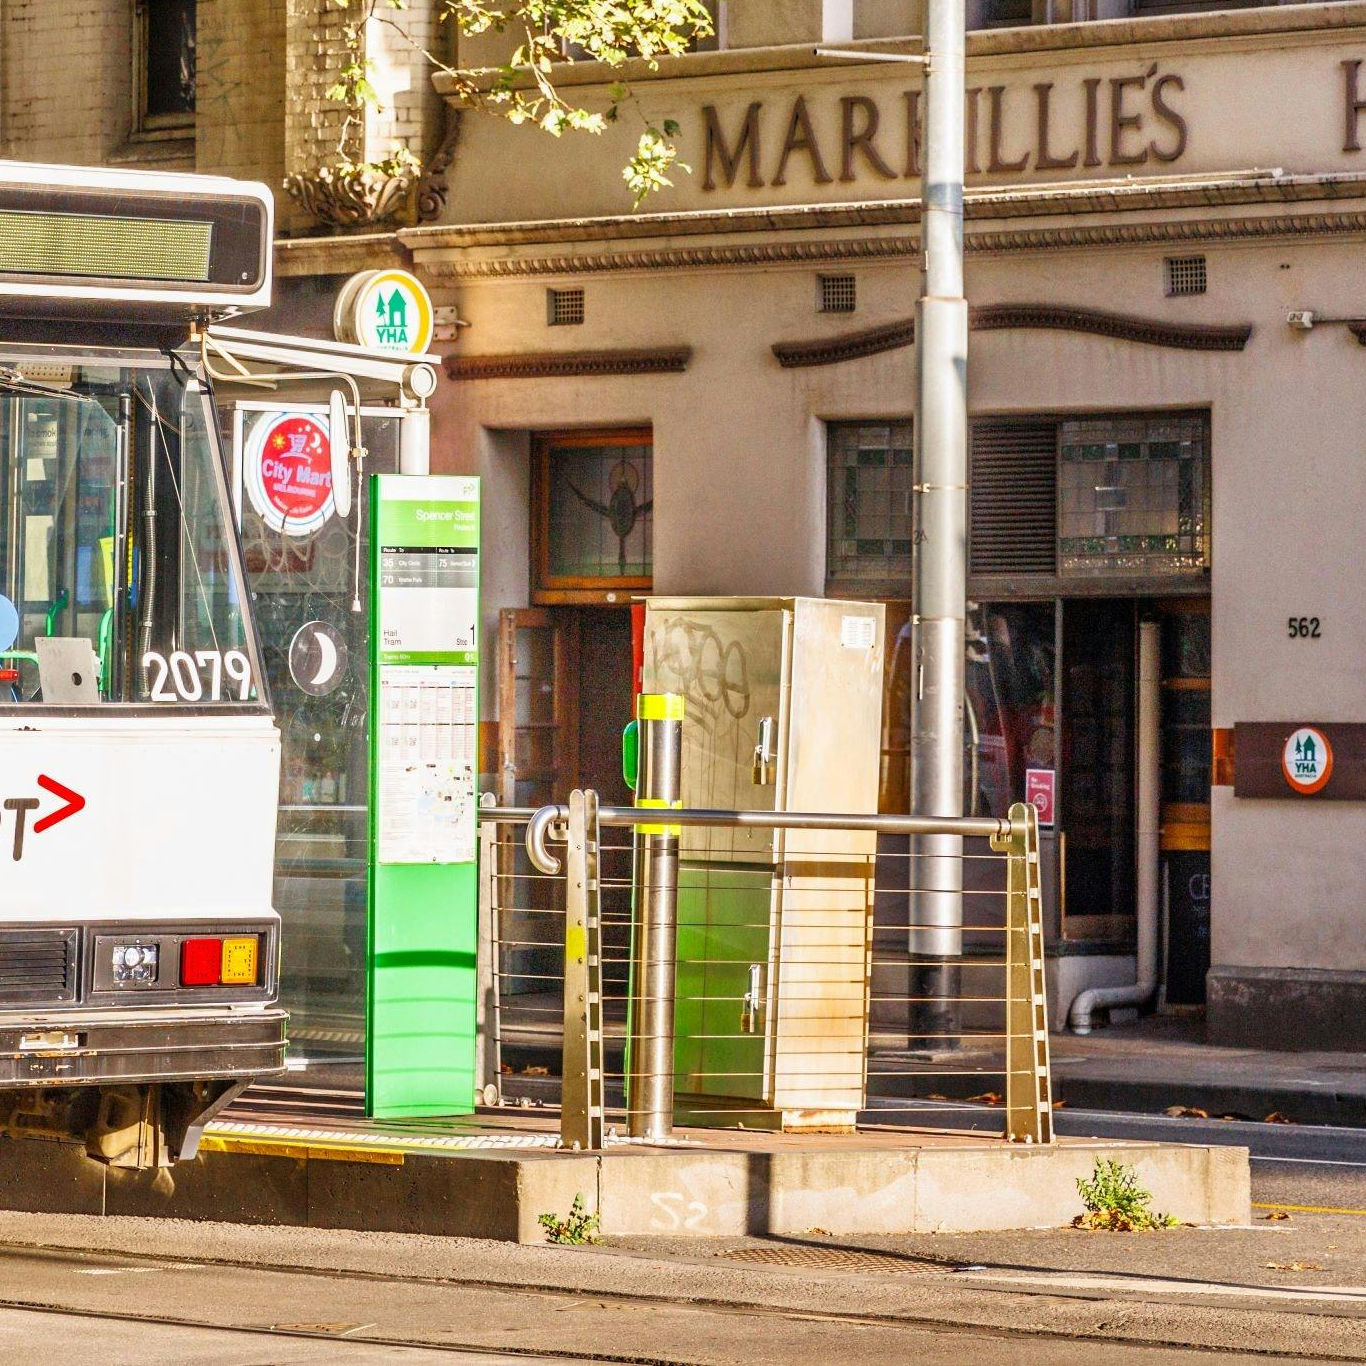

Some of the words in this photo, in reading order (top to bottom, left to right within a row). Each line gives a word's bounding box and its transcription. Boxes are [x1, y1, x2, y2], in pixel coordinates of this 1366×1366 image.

[376, 328, 408, 343] YHA
[262, 459, 293, 484] City
[295, 465, 332, 488] Mart
[416, 509, 453, 522] Spencer
[383, 558, 394, 567] 35
[439, 559, 448, 568] 75
[383, 575, 394, 584] 70
[383, 629, 398, 637] Hail
[1288, 617, 1322, 638] 562
[383, 638, 402, 646] Tram
[469, 624, 475, 646] 1
[142, 650, 251, 702] 2079
[1295, 762, 1317, 773] YHA
